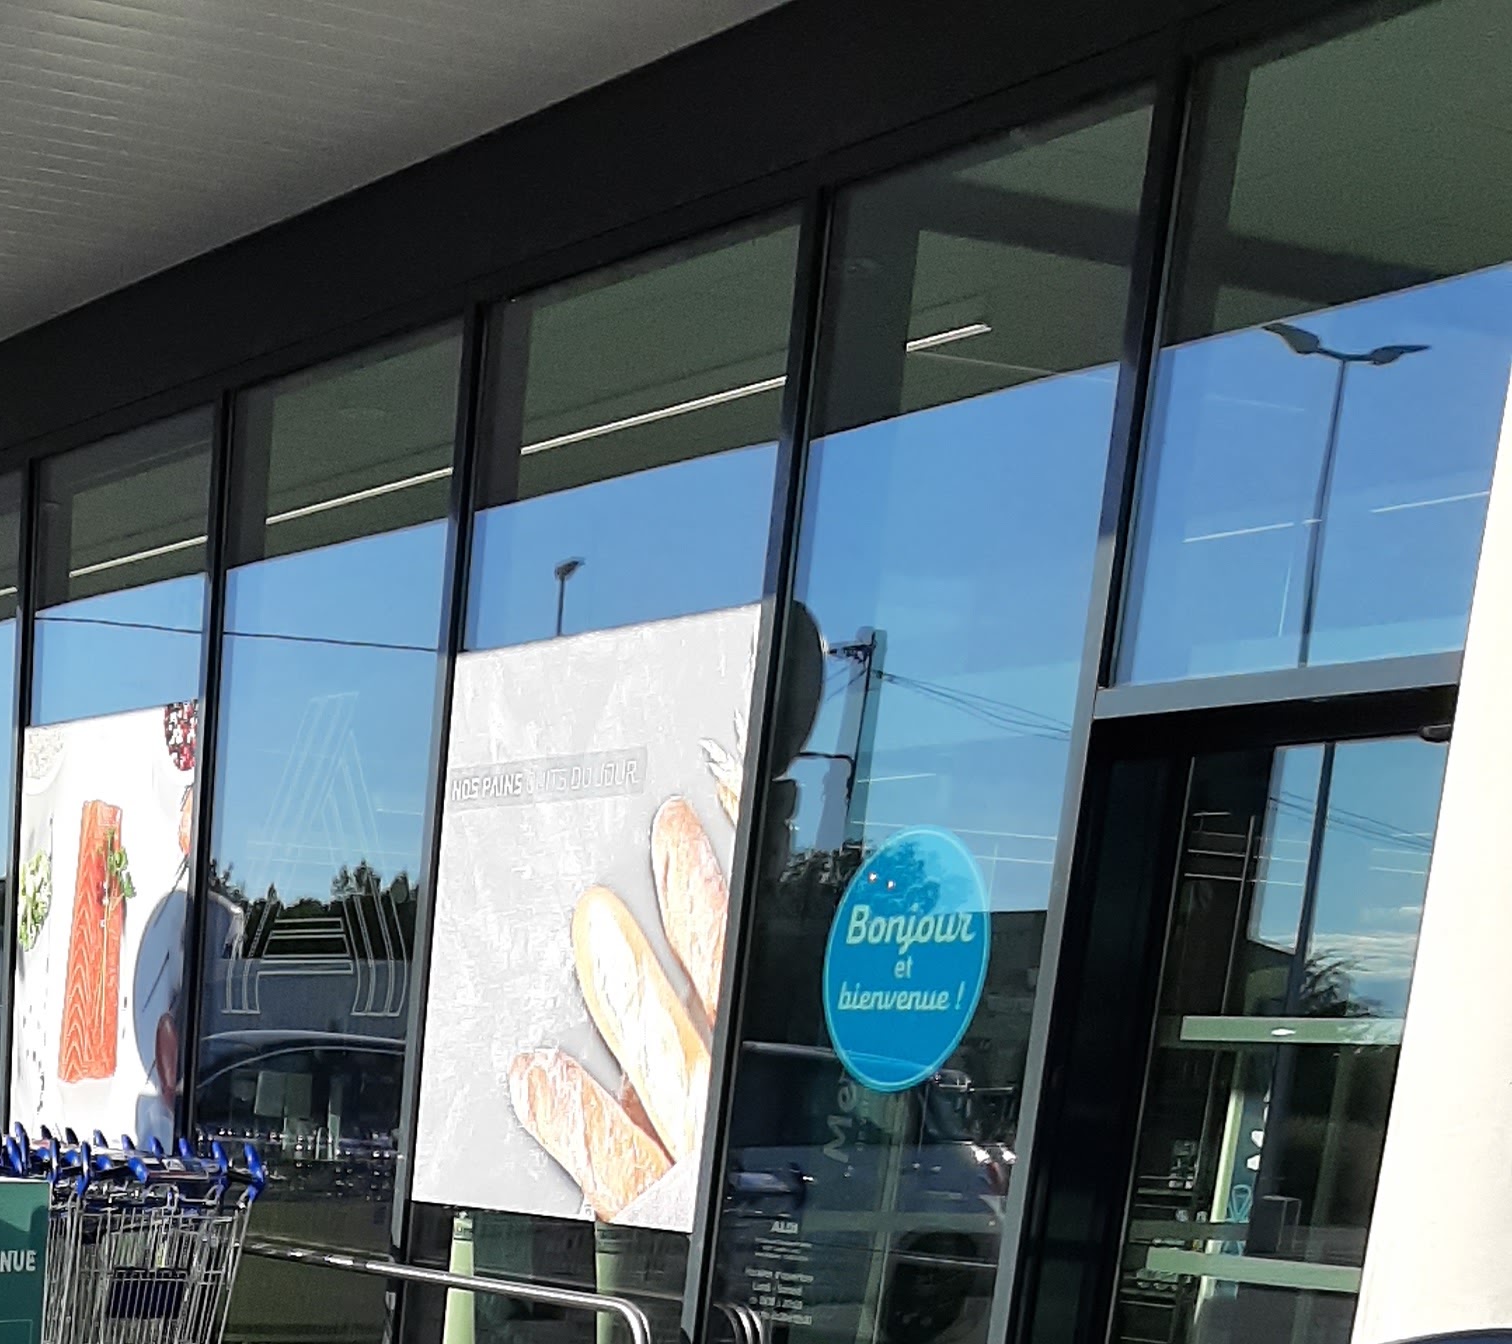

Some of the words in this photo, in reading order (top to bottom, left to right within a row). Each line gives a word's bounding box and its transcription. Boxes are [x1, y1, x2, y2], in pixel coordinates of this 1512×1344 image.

[451, 777, 479, 801] NOS
[482, 773, 523, 798] PAINS
[571, 766, 591, 790] DU
[595, 760, 639, 787] JOUR
[846, 902, 977, 956] Bonjour
[894, 955, 913, 979] et
[838, 981, 950, 1010] bienvenue
